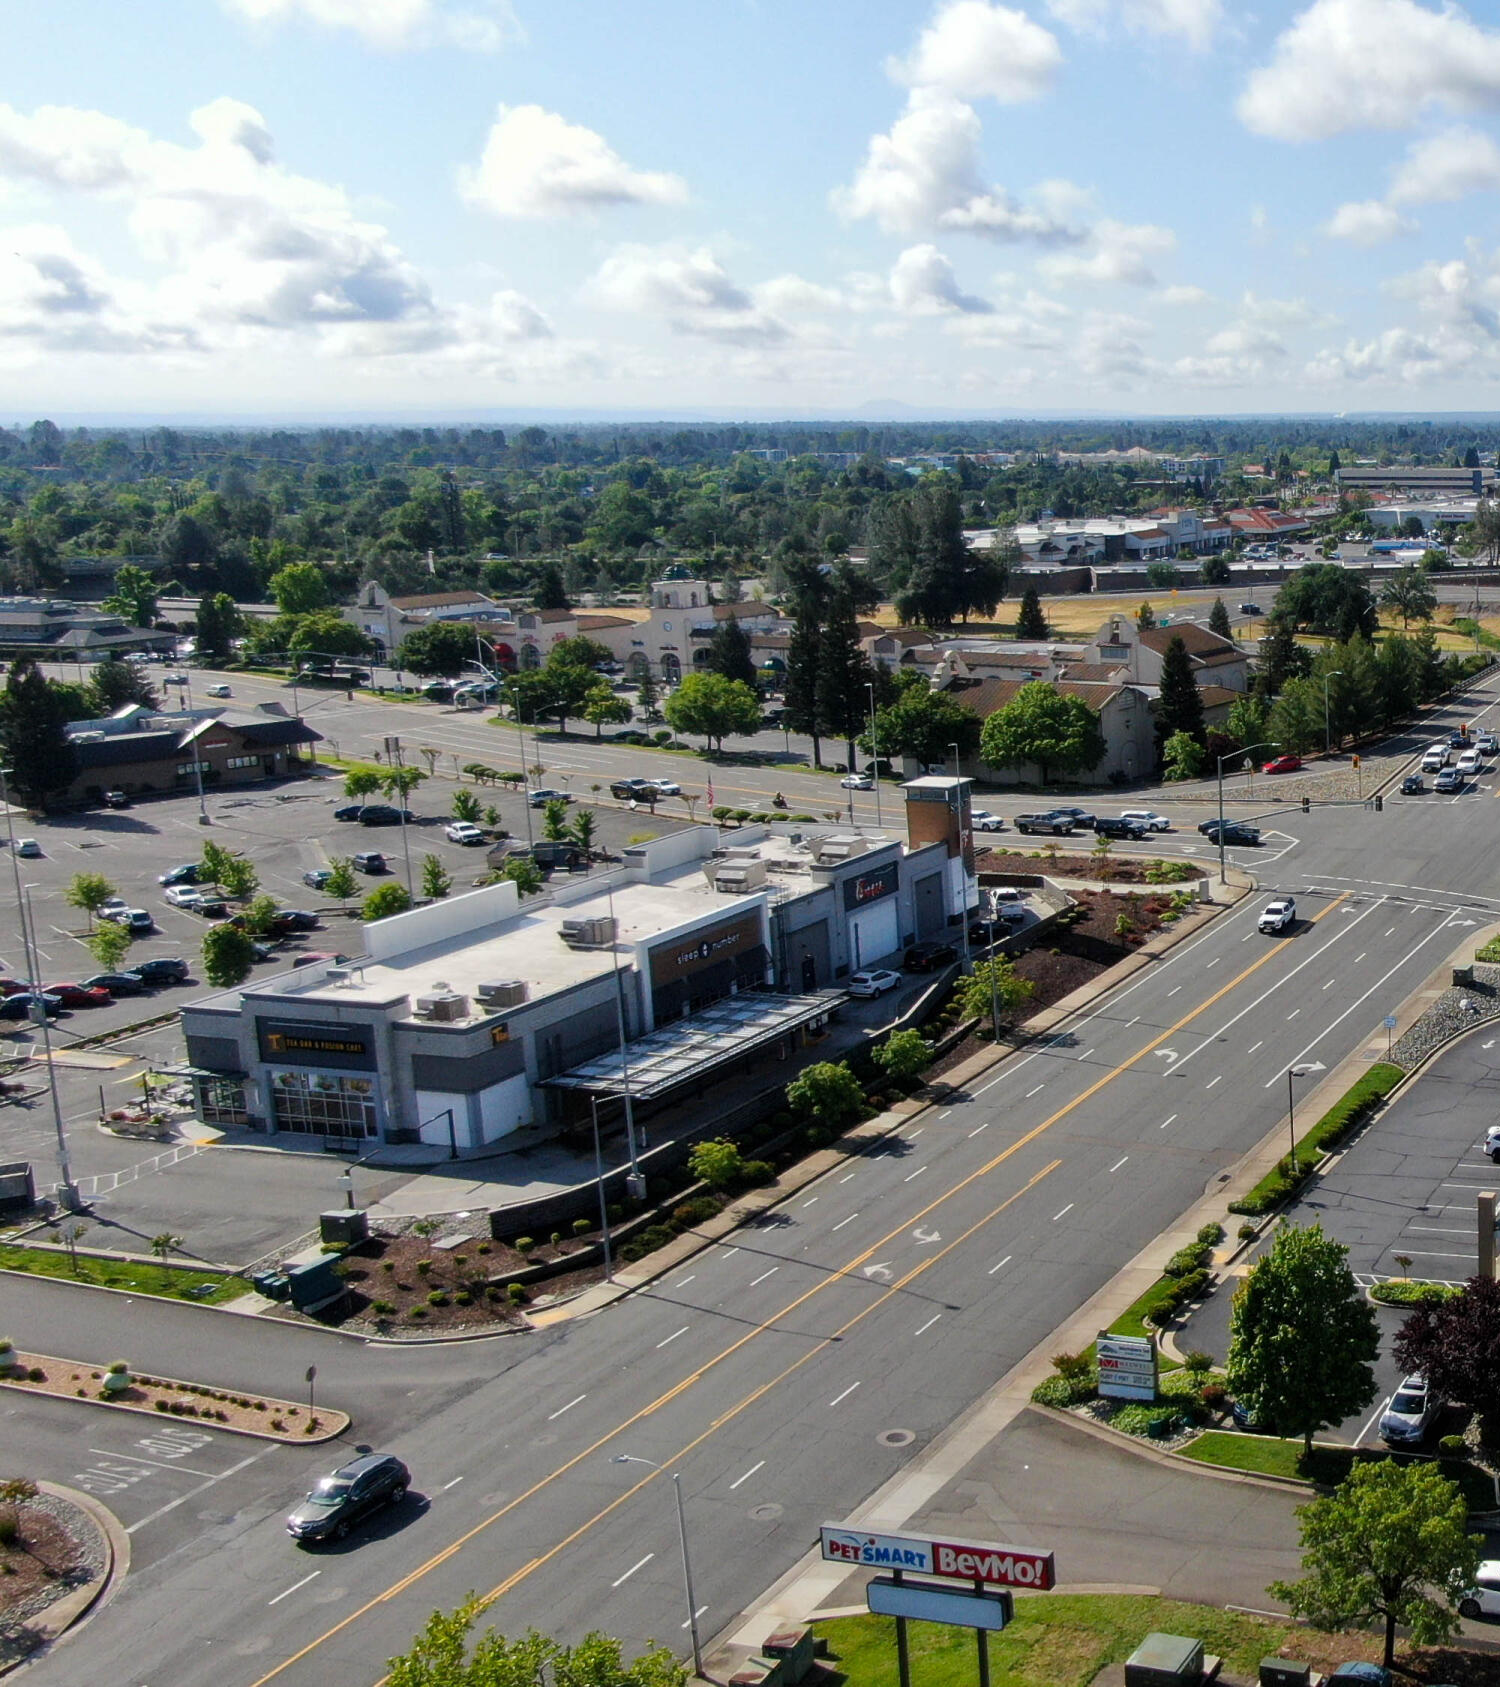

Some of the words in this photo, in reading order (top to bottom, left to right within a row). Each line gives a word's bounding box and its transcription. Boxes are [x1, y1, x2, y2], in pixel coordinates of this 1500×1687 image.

[677, 949, 699, 965] sleep
[712, 933, 740, 950] number
[828, 1538, 927, 1569] PETSMART
[938, 1547, 1044, 1586] BevMo!
